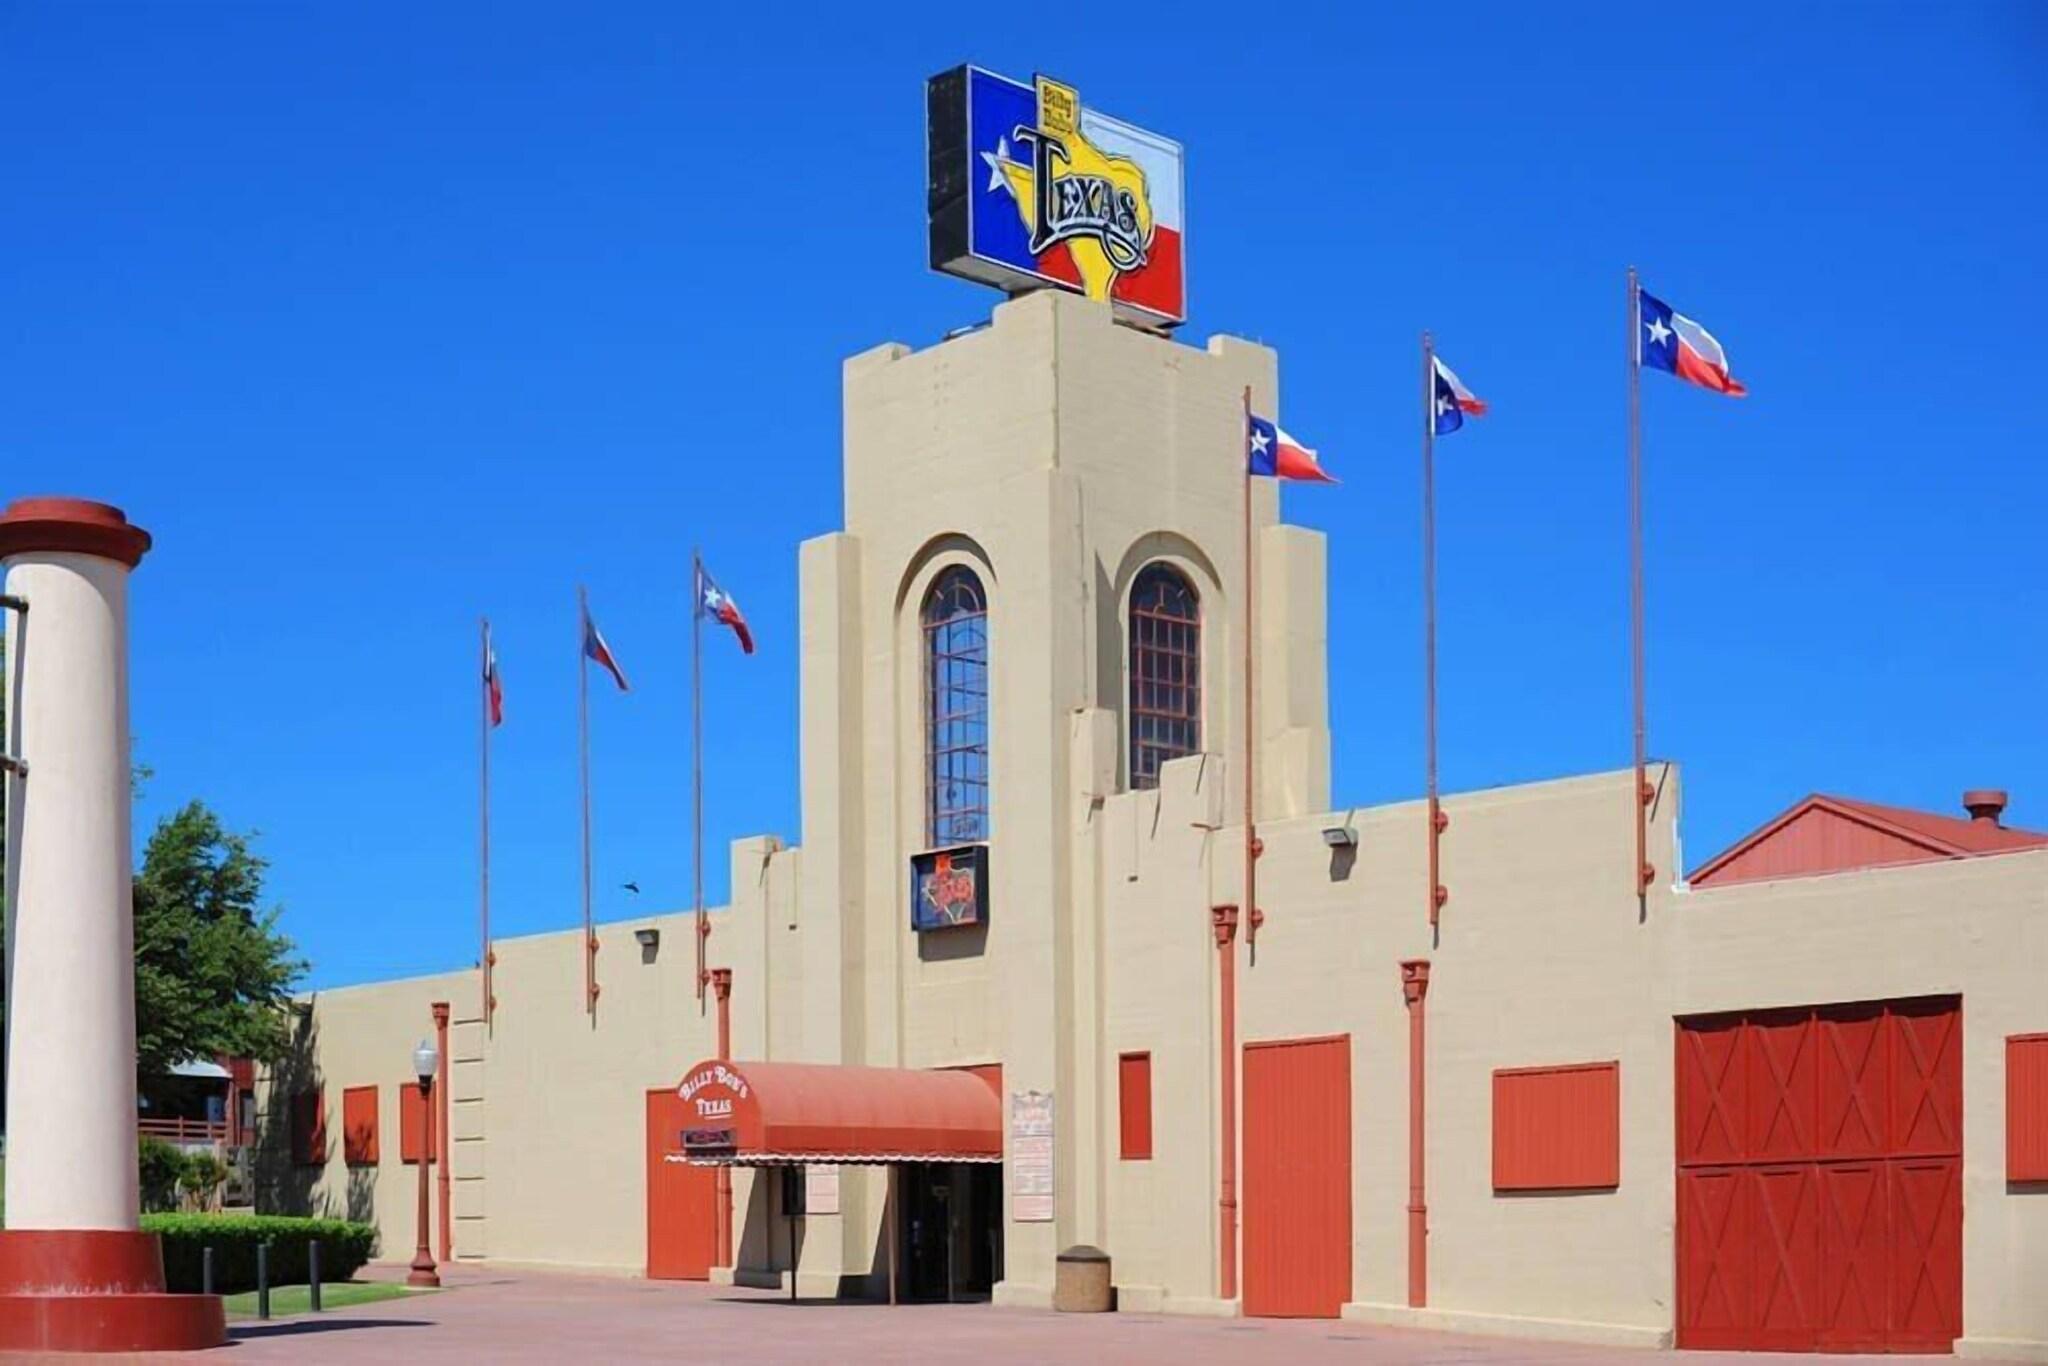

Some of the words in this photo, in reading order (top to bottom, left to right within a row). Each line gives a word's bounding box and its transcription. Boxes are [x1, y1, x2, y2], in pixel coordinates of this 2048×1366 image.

[1013, 124, 1144, 265] TEXAS
[678, 1070, 714, 1101] BILLY
[695, 1098, 732, 1116] TEXAS
